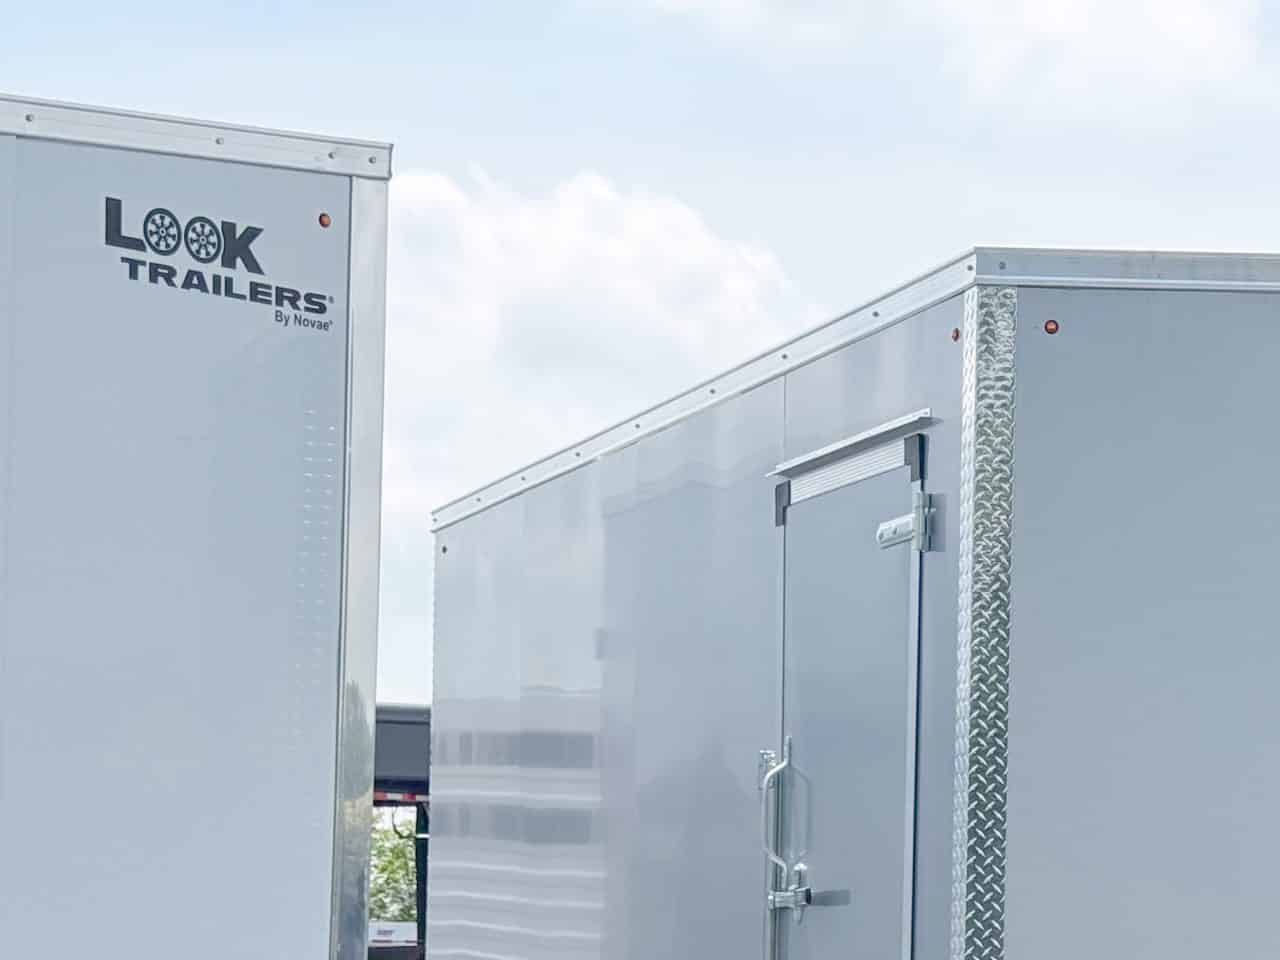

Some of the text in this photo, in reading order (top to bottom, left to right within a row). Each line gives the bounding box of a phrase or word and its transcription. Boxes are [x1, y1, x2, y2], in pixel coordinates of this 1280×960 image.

[105, 196, 265, 276] LOOK
[120, 256, 328, 315] TRAILERS
[274, 310, 330, 331] By Novae
